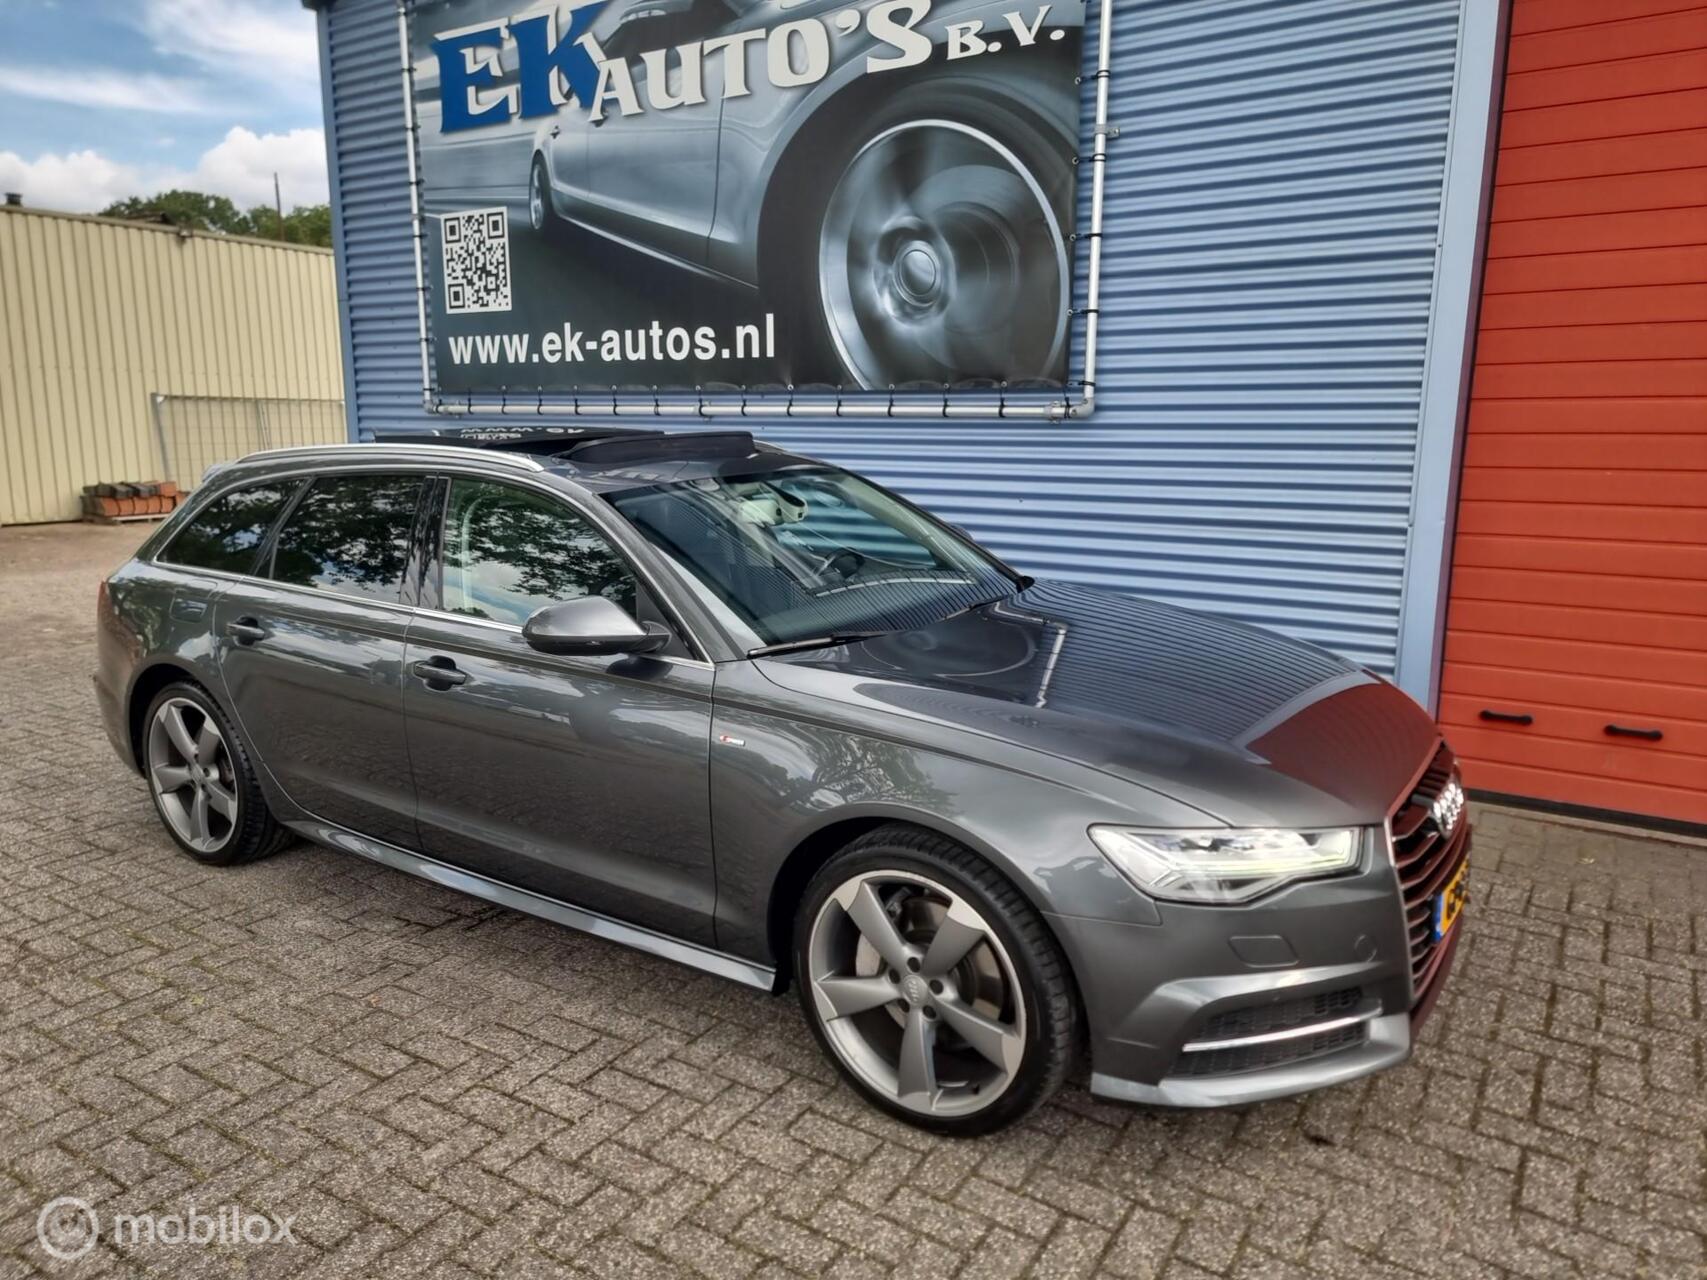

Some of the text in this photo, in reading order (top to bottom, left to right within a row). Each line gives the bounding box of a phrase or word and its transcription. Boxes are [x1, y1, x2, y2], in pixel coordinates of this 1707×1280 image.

[430, 0, 608, 133] EK
[945, 5, 1066, 61] B.V.
[448, 313, 775, 365] www.ek-autos.nl
